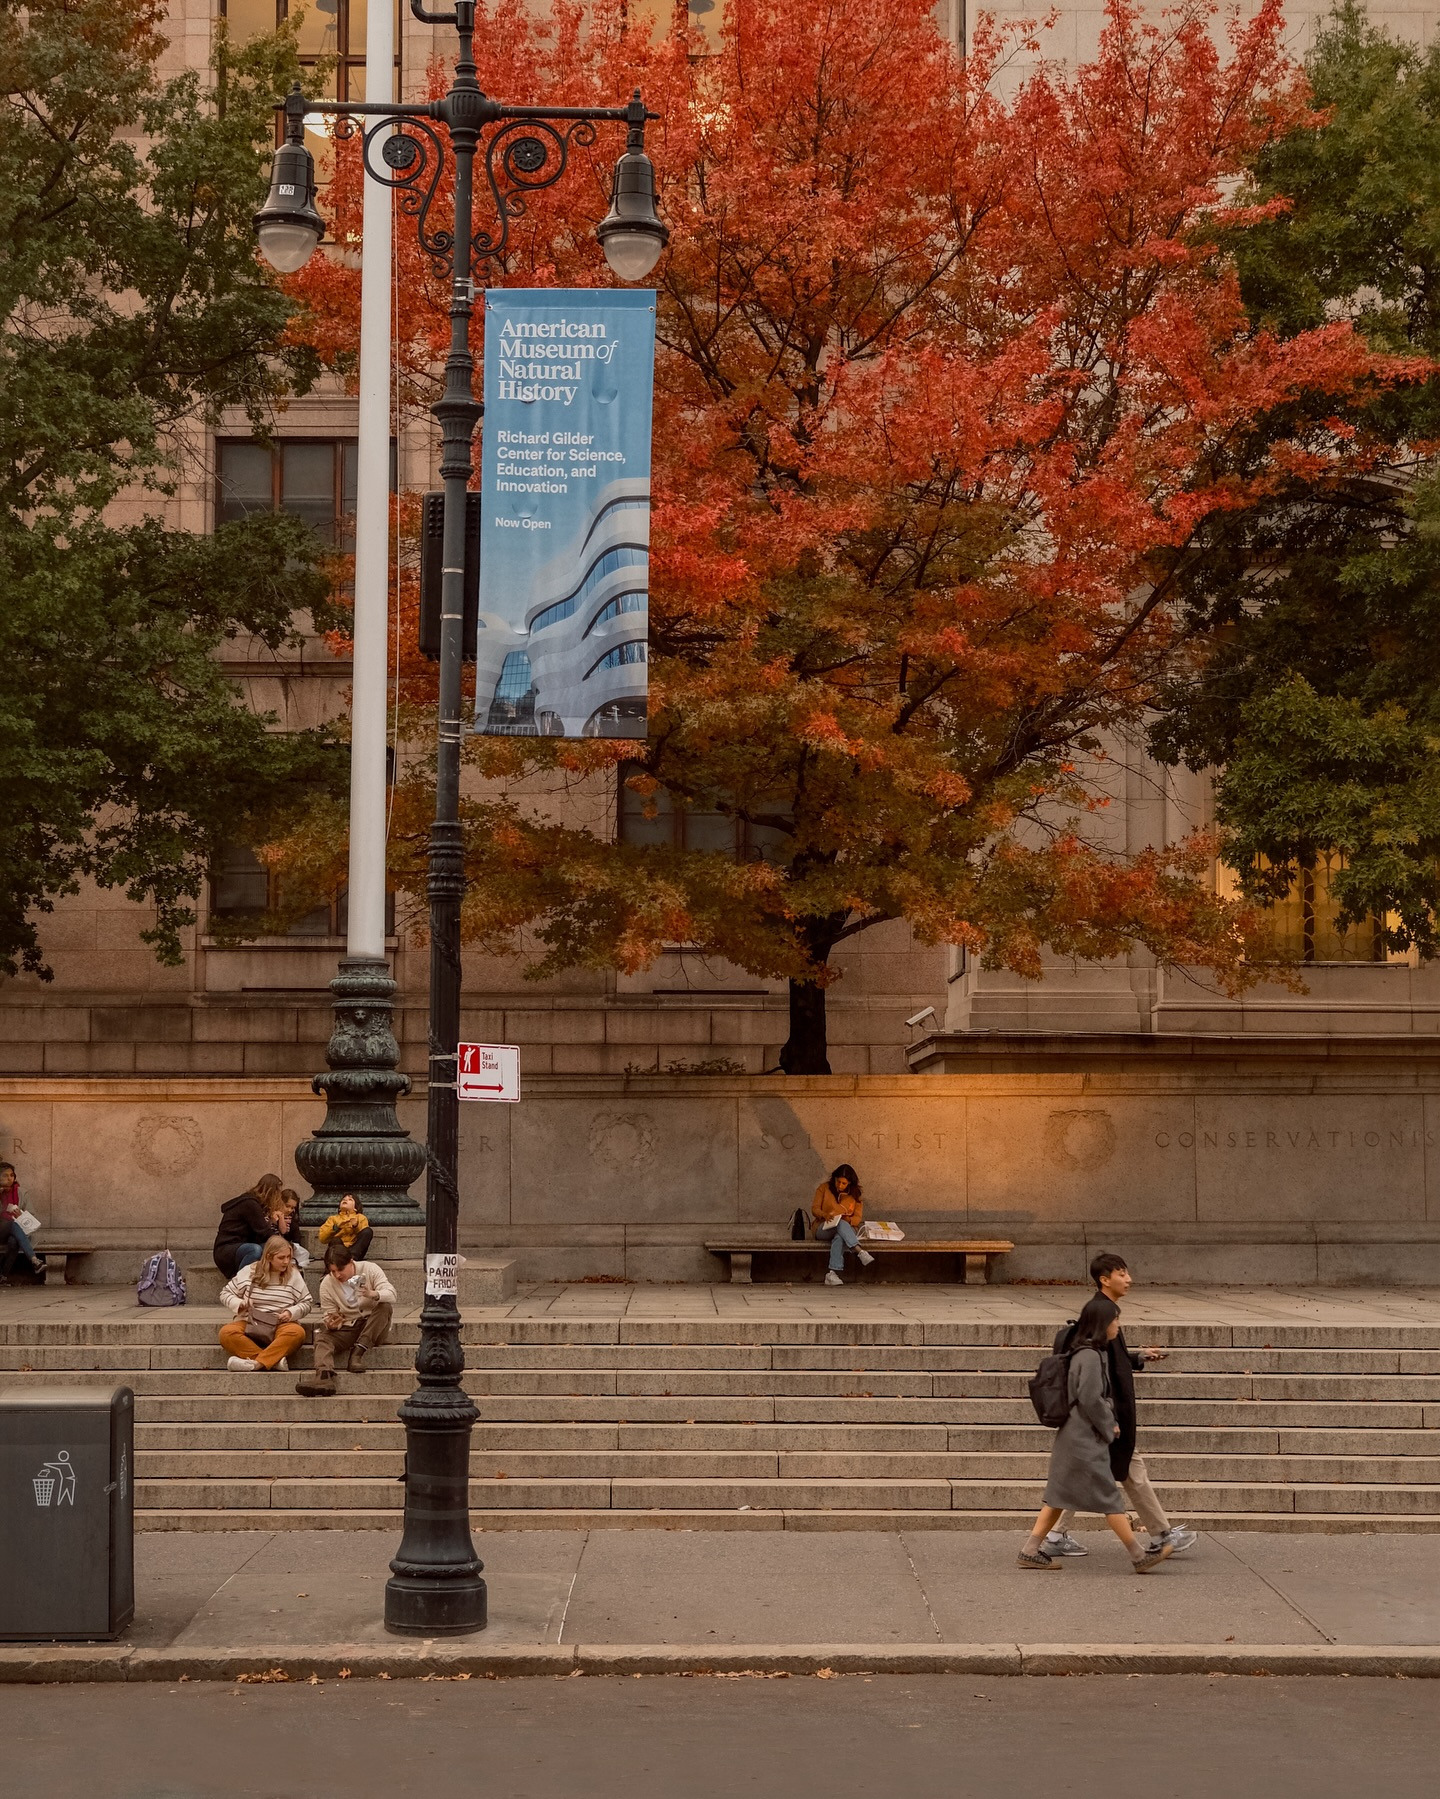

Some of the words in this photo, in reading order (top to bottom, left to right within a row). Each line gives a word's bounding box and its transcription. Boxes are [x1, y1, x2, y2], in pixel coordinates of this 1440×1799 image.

[499, 319, 606, 338] American
[499, 339, 595, 359] Museum
[596, 340, 619, 364] of
[499, 360, 581, 380] Natural
[498, 380, 578, 406] History
[498, 430, 549, 445] Richard
[552, 431, 594, 445] Gilder
[497, 447, 544, 461] Center
[546, 447, 566, 461] for
[569, 449, 626, 464] Science,
[496, 463, 568, 480] Education,
[571, 464, 597, 478] and
[496, 479, 568, 493] Innovation
[495, 517, 520, 528] Now
[522, 518, 551, 530] Open
[481, 1051, 494, 1061] Taxi
[481, 1061, 499, 1070] Stand
[760, 1133, 947, 1150] SCIENTIST
[1154, 1131, 1435, 1149] CONSERVATIONIS
[444, 1256, 457, 1266] NO
